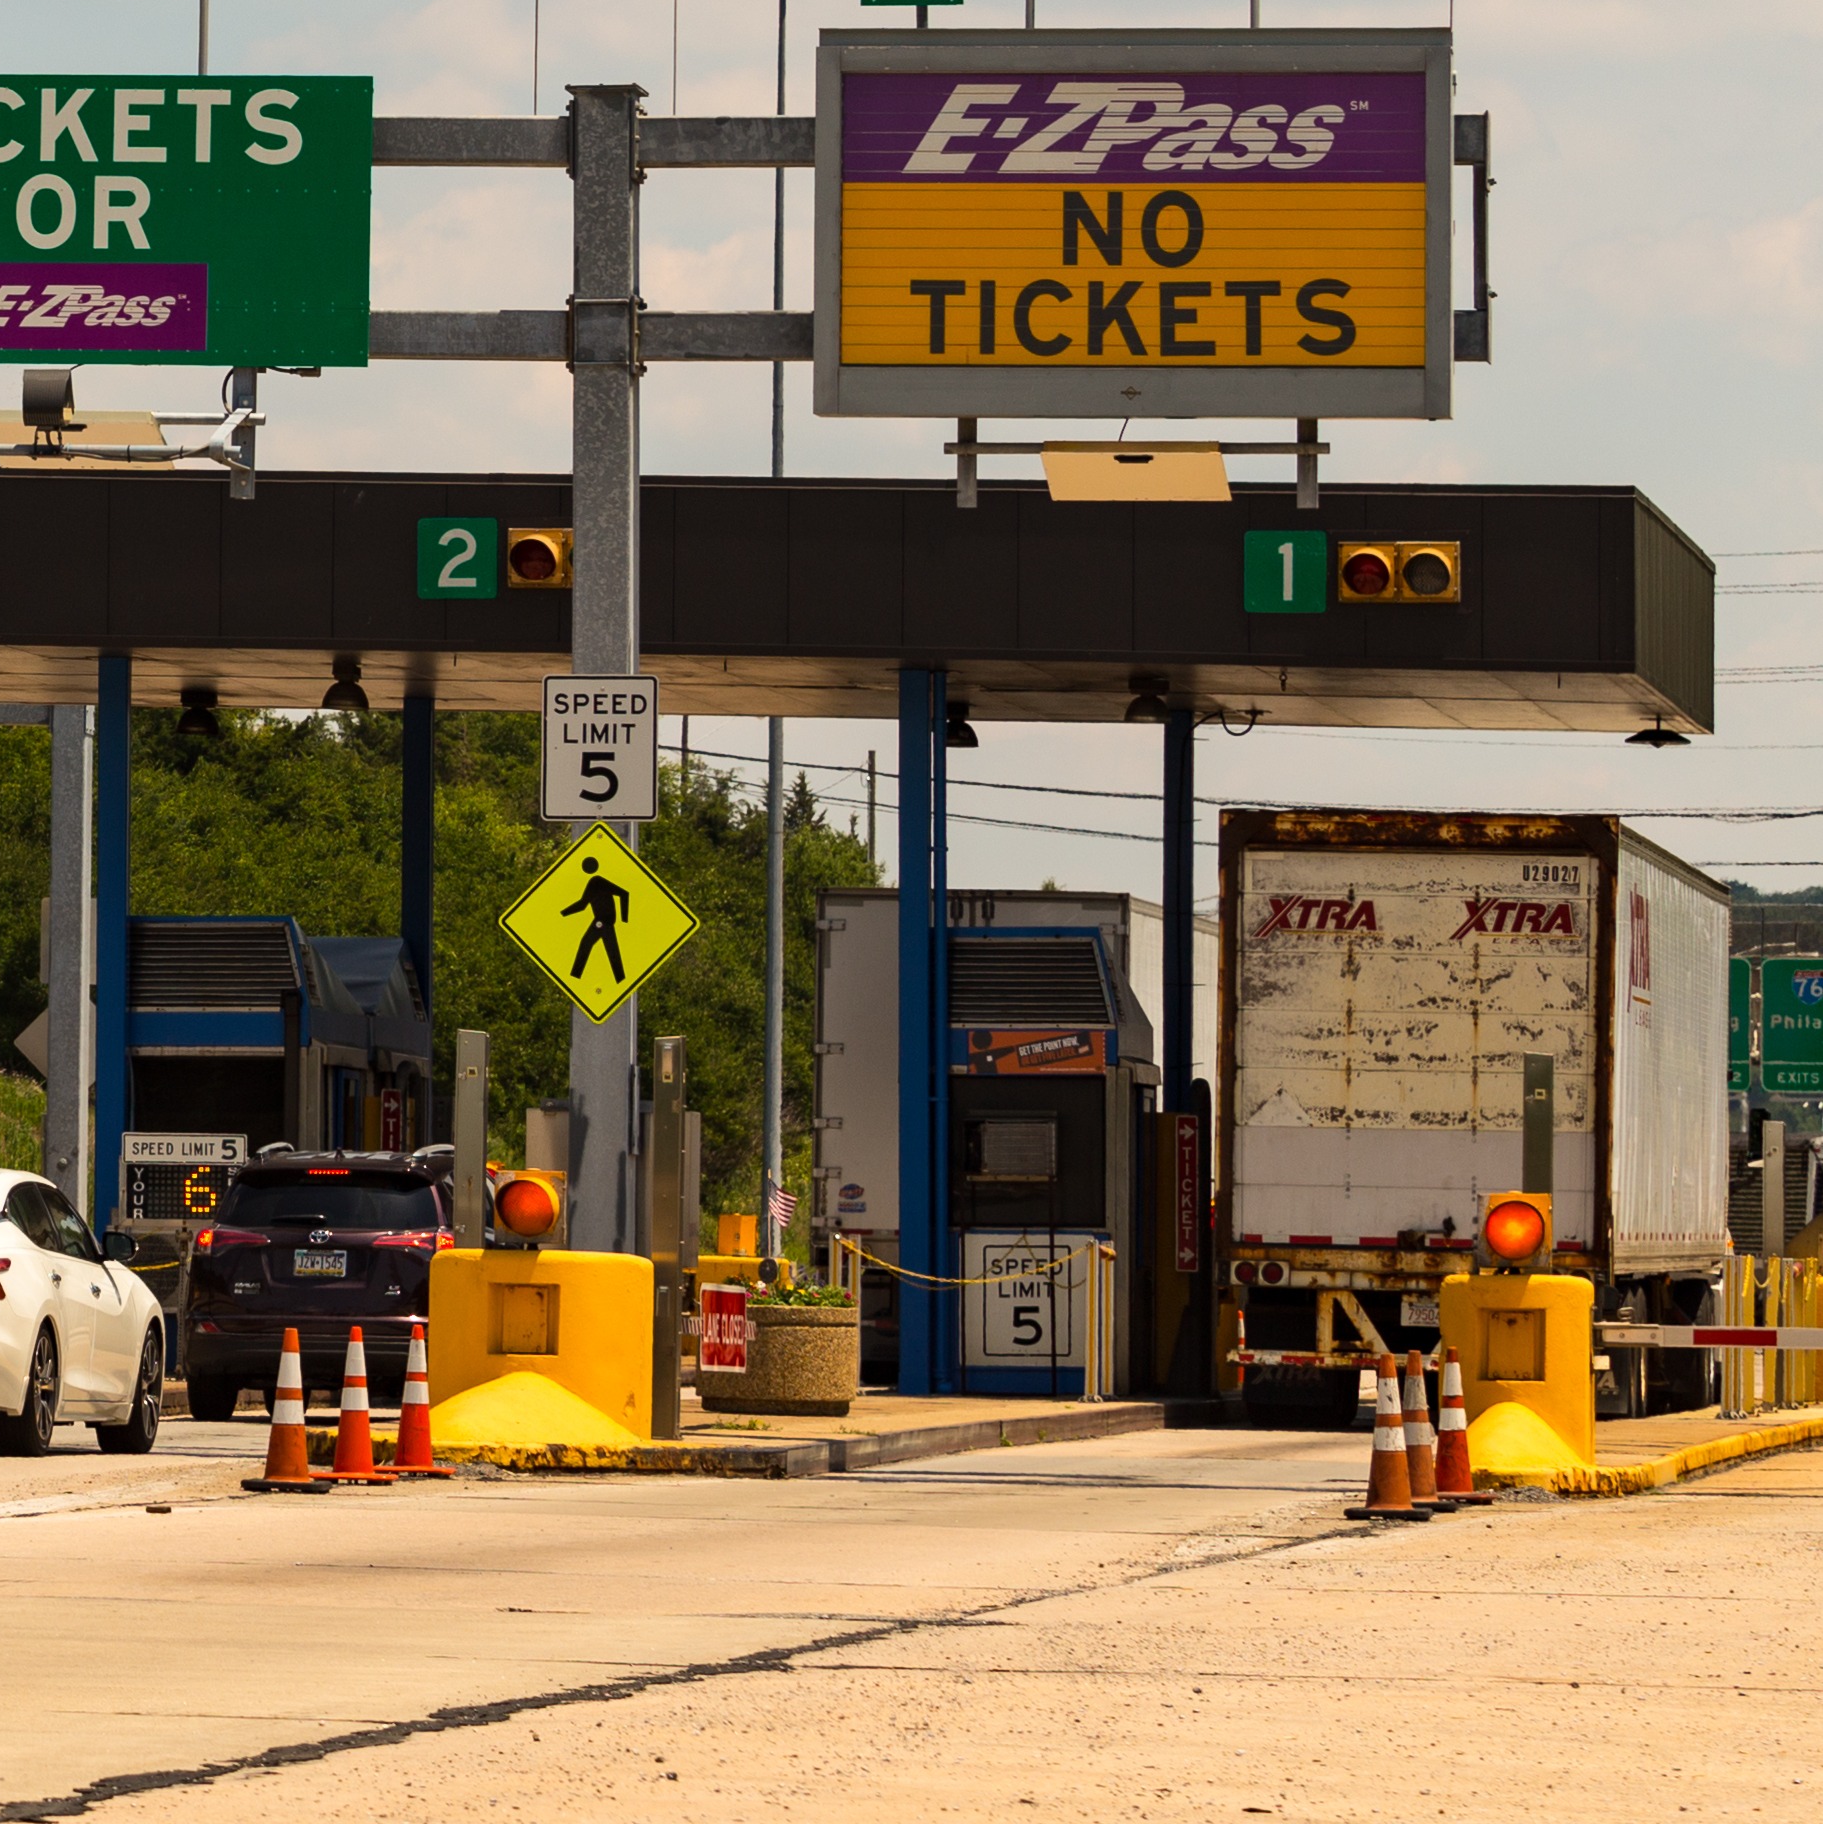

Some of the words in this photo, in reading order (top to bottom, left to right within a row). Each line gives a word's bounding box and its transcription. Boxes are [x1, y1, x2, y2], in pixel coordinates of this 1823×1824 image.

[901, 81, 1347, 175] E-ZPass
[15, 173, 152, 250] OR
[1061, 189, 1205, 269] NO
[909, 277, 1357, 358] TICKETS
[437, 527, 478, 588] 2
[1277, 542, 1294, 602] 1
[553, 692, 648, 715] SPEED
[563, 722, 636, 745] LIMIT
[578, 751, 619, 803] 5
[1522, 864, 1580, 882] U29027
[1250, 894, 1378, 940] XTRA
[1448, 897, 1575, 941] XTRA
[1794, 977, 1823, 998] 76
[1776, 1071, 1820, 1085] EXITS
[131, 1141, 174, 1156] SPEED
[181, 1141, 215, 1157] LIMIT
[220, 1138, 238, 1161] 5
[184, 1166, 217, 1213] 6
[1181, 1146, 1193, 1240] TICKET
[990, 1258, 1064, 1276] SPEED
[998, 1281, 1054, 1299] LIMIT
[702, 1312, 720, 1344] LANE
[1012, 1305, 1044, 1347] 5
